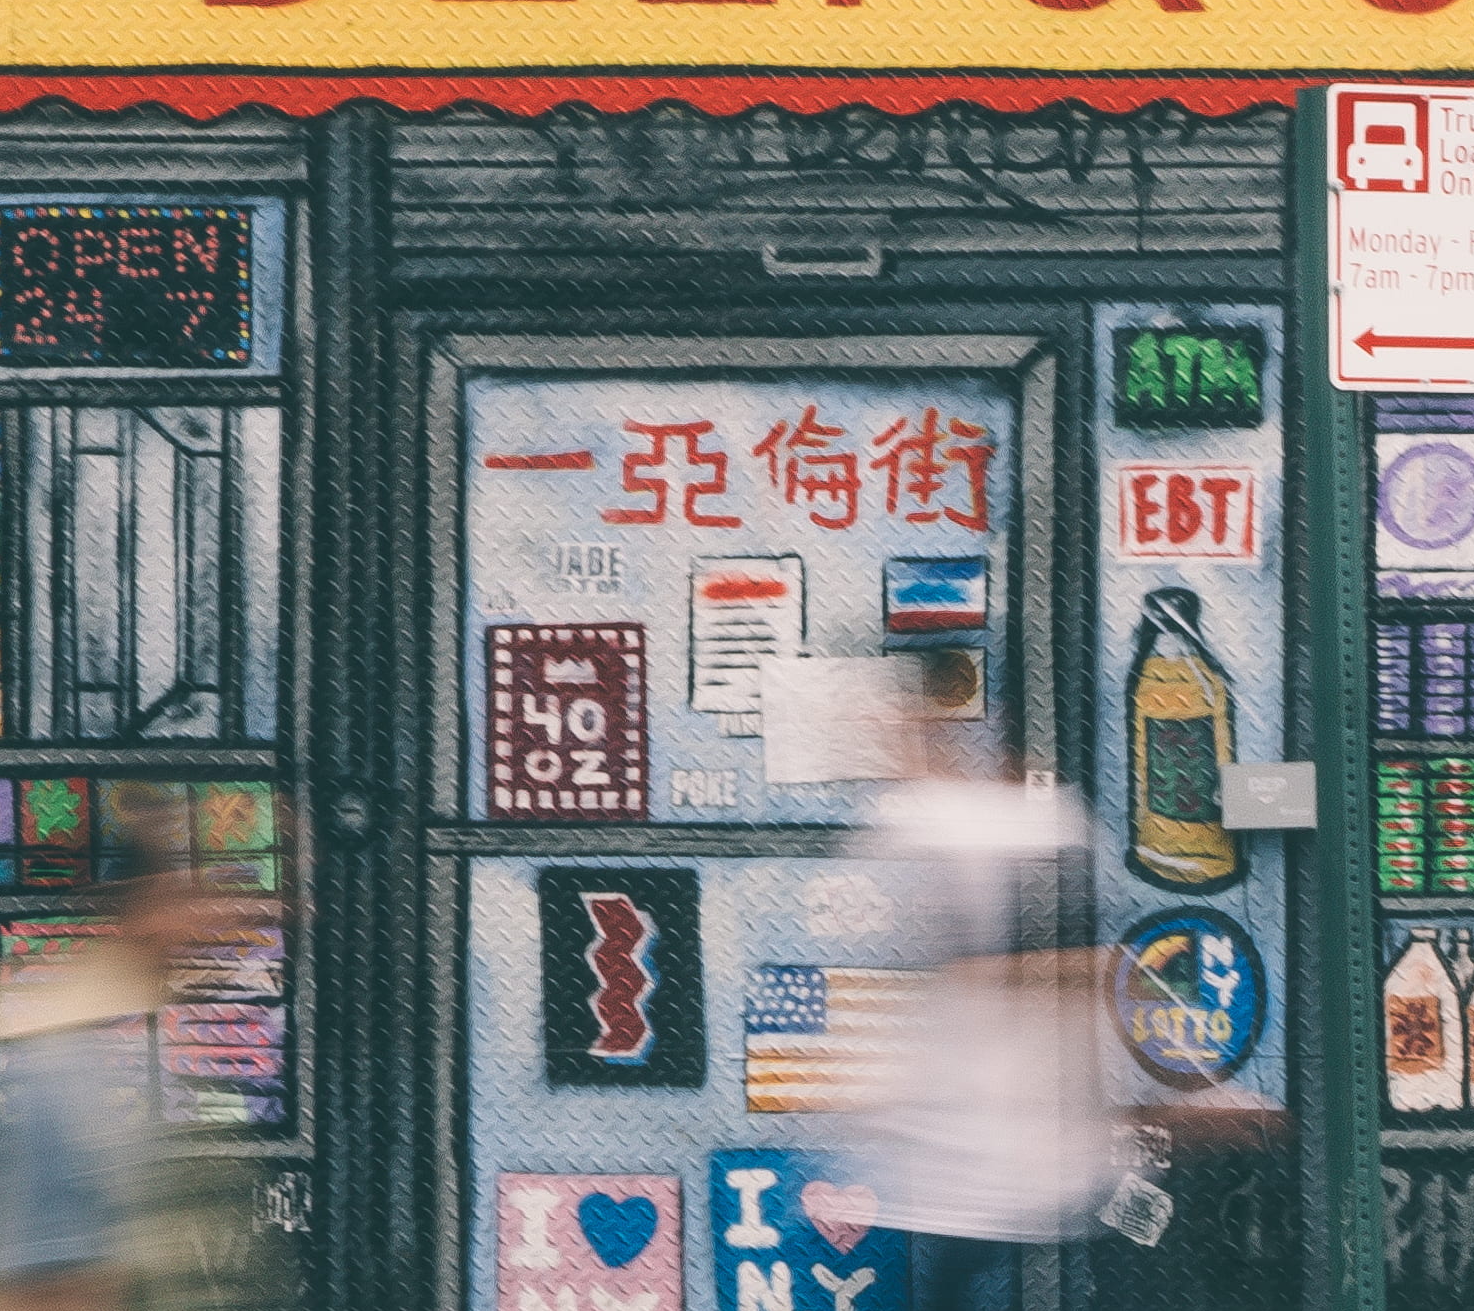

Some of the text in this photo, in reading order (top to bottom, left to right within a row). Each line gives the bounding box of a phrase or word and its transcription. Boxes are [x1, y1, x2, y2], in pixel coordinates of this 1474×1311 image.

[11, 225, 220, 278] OPEN
[1348, 226, 1442, 260] Monday
[1348, 263, 1401, 291] 7am
[1123, 330, 1260, 408] ATM
[1132, 473, 1243, 545] EBT
[522, 693, 608, 746] 40
[524, 748, 612, 786] OZ
[1132, 1005, 1234, 1043] LOTTO
[509, 1187, 562, 1270] I
[724, 1167, 782, 1250] I
